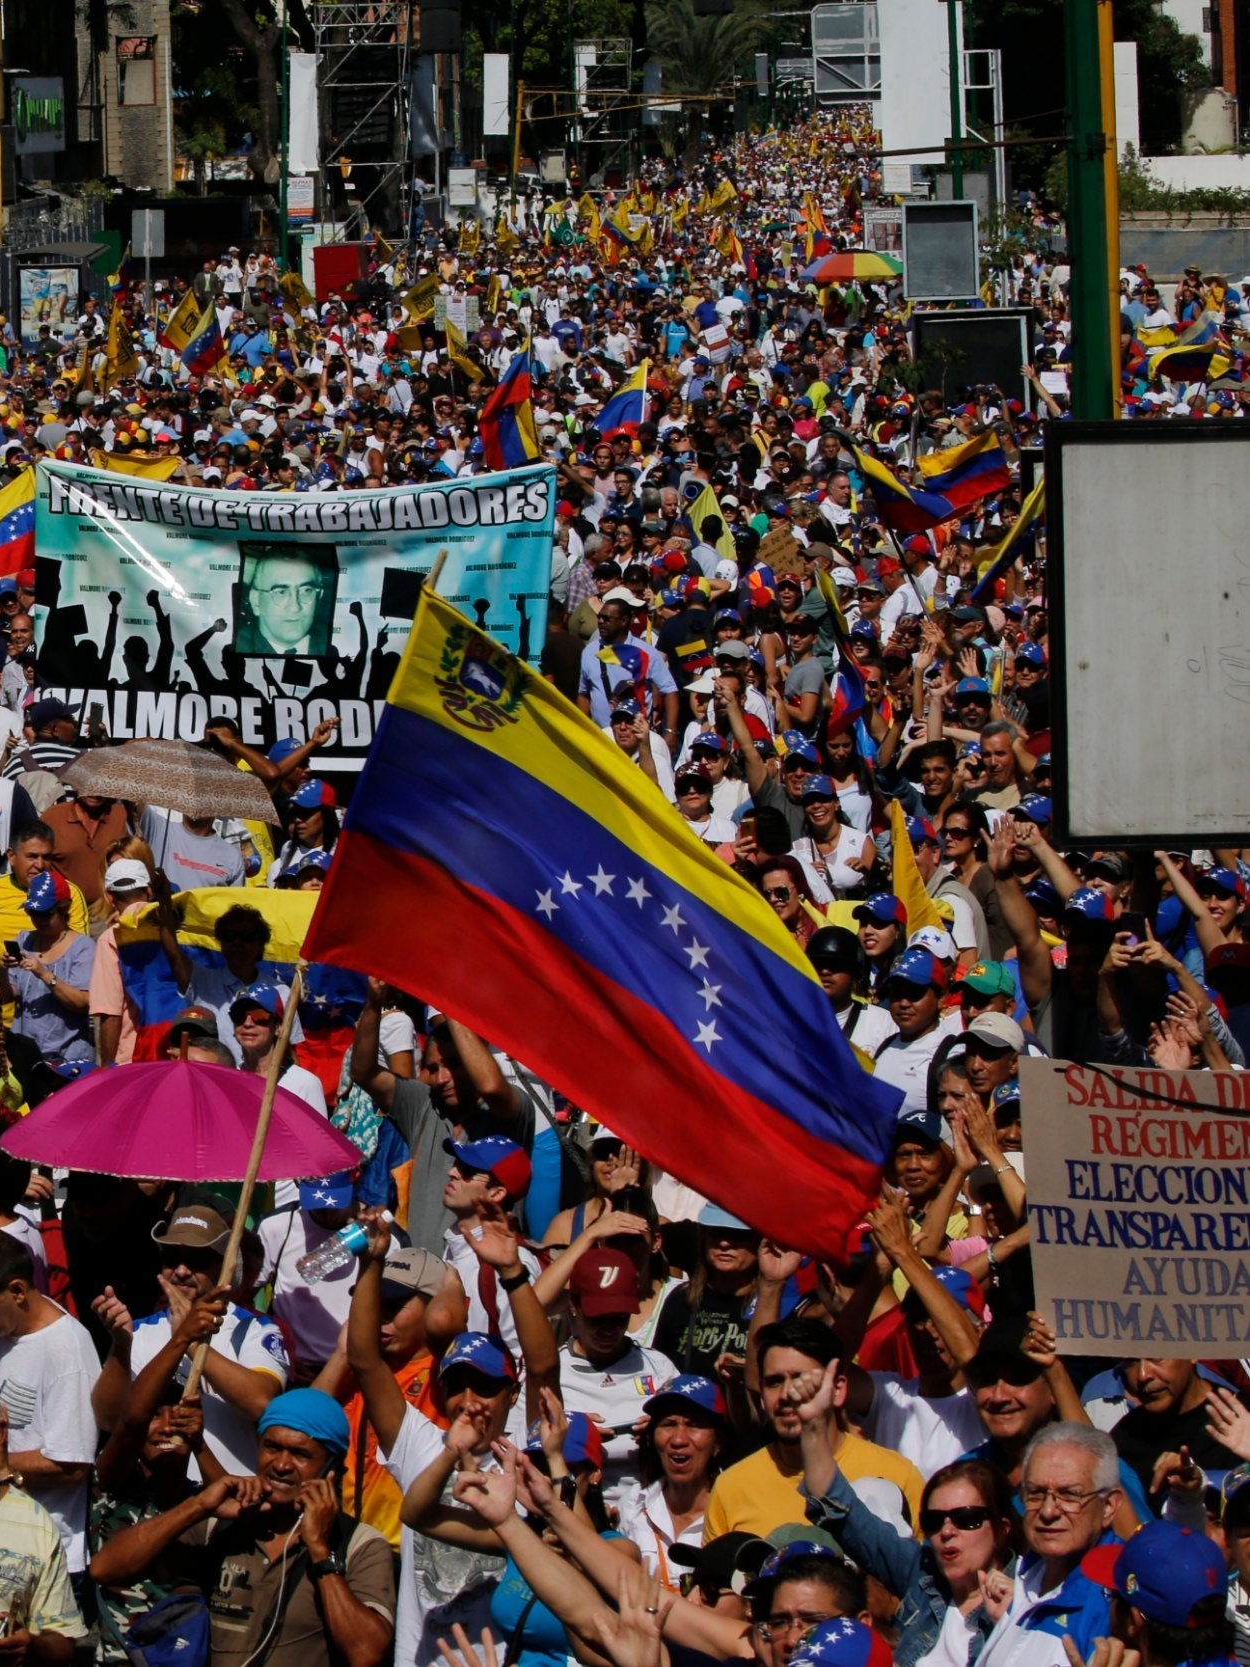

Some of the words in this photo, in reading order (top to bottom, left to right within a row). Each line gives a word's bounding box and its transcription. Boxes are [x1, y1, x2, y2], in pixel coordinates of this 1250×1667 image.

[49, 473, 185, 527] FRENTE
[187, 495, 240, 530] DE
[245, 480, 550, 531] TRABAJADORES
[274, 698, 387, 748] ROD
[1064, 1064, 1200, 1112] SALIDA
[1123, 1257, 1250, 1297] AYUDA
